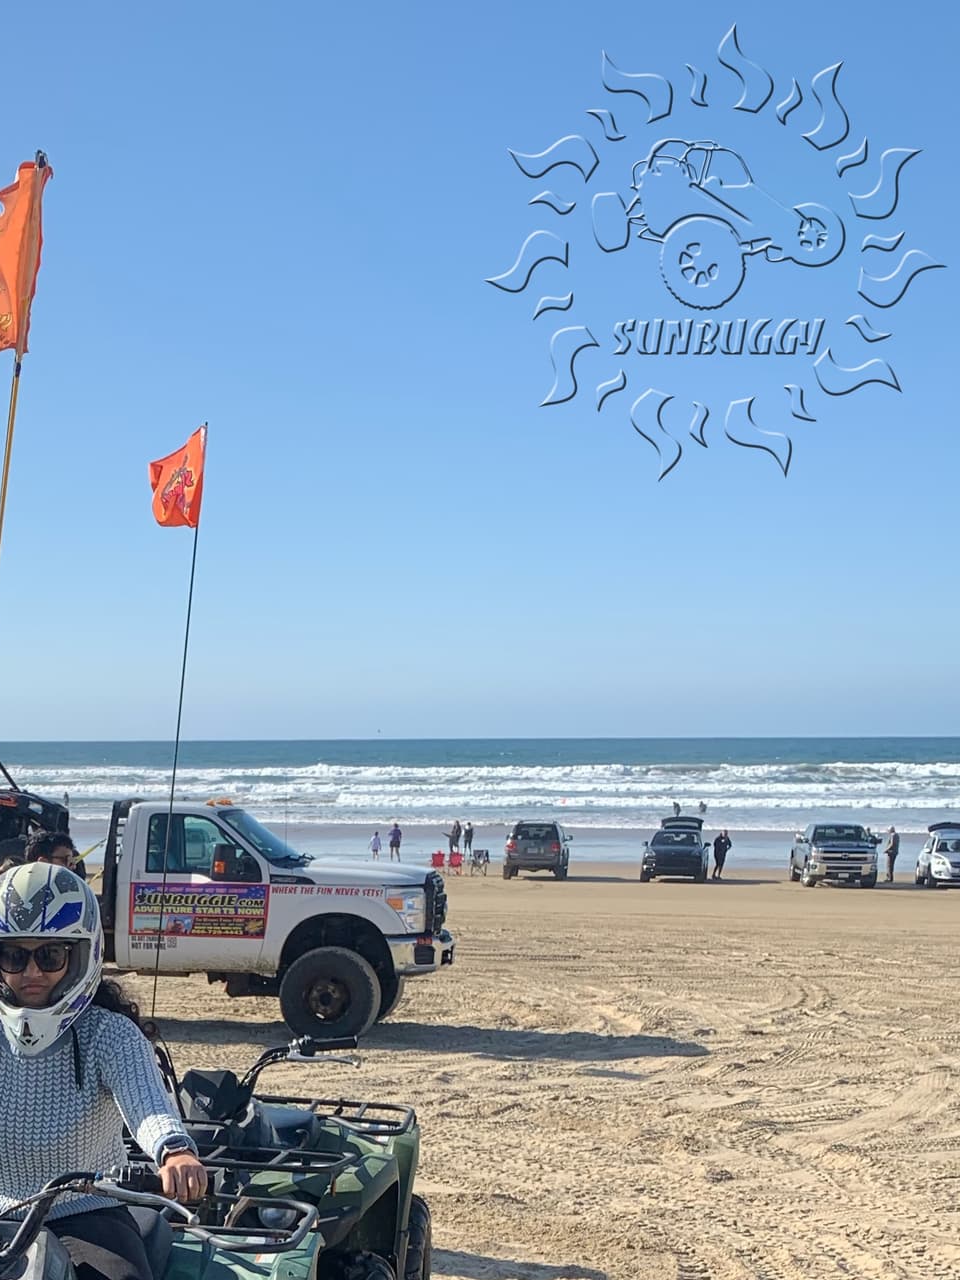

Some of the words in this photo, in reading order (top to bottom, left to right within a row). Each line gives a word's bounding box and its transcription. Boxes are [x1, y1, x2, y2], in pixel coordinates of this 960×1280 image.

[271, 886, 298, 895] WHERE
[300, 886, 314, 895] THE
[316, 887, 333, 895] FUN
[335, 888, 360, 896] NEVER
[362, 889, 384, 897] SETS!
